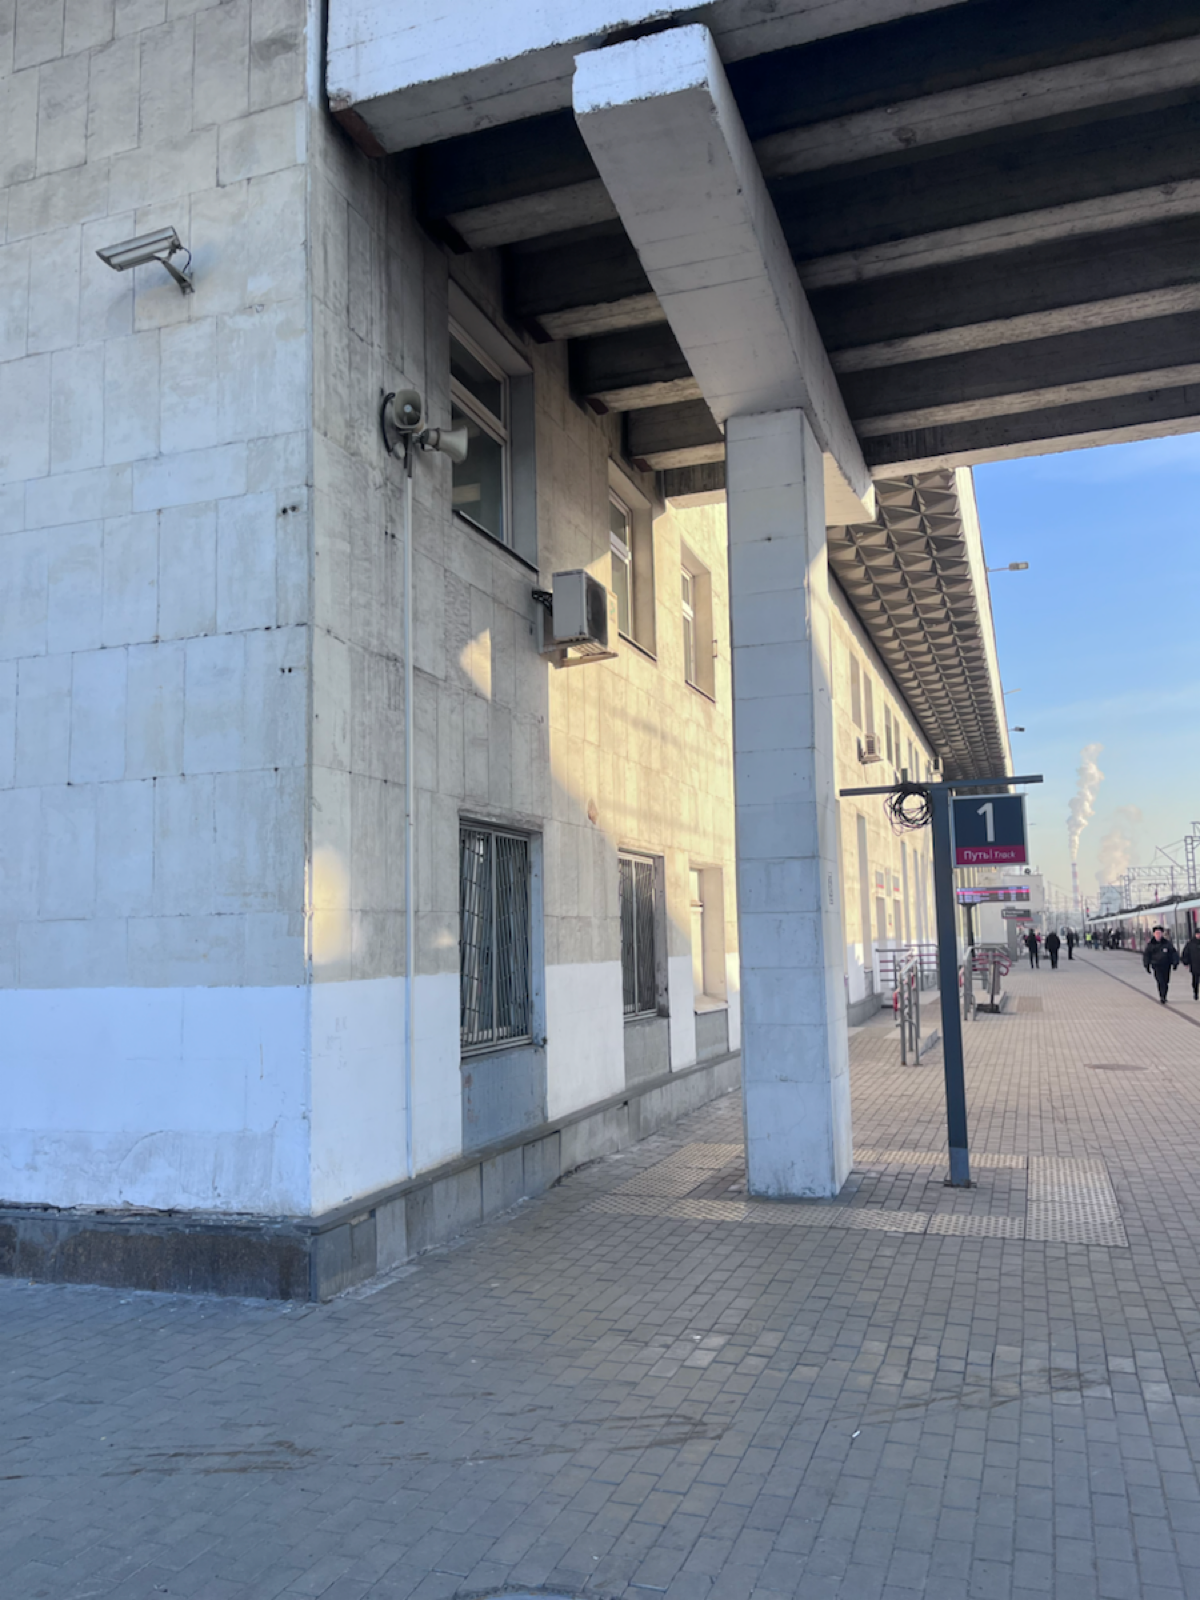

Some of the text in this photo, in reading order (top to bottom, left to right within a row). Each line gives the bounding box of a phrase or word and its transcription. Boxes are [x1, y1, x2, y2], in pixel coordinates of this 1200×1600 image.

[976, 802, 995, 842] 1
[963, 850, 990, 862] Путь
[994, 850, 1016, 859] Track
